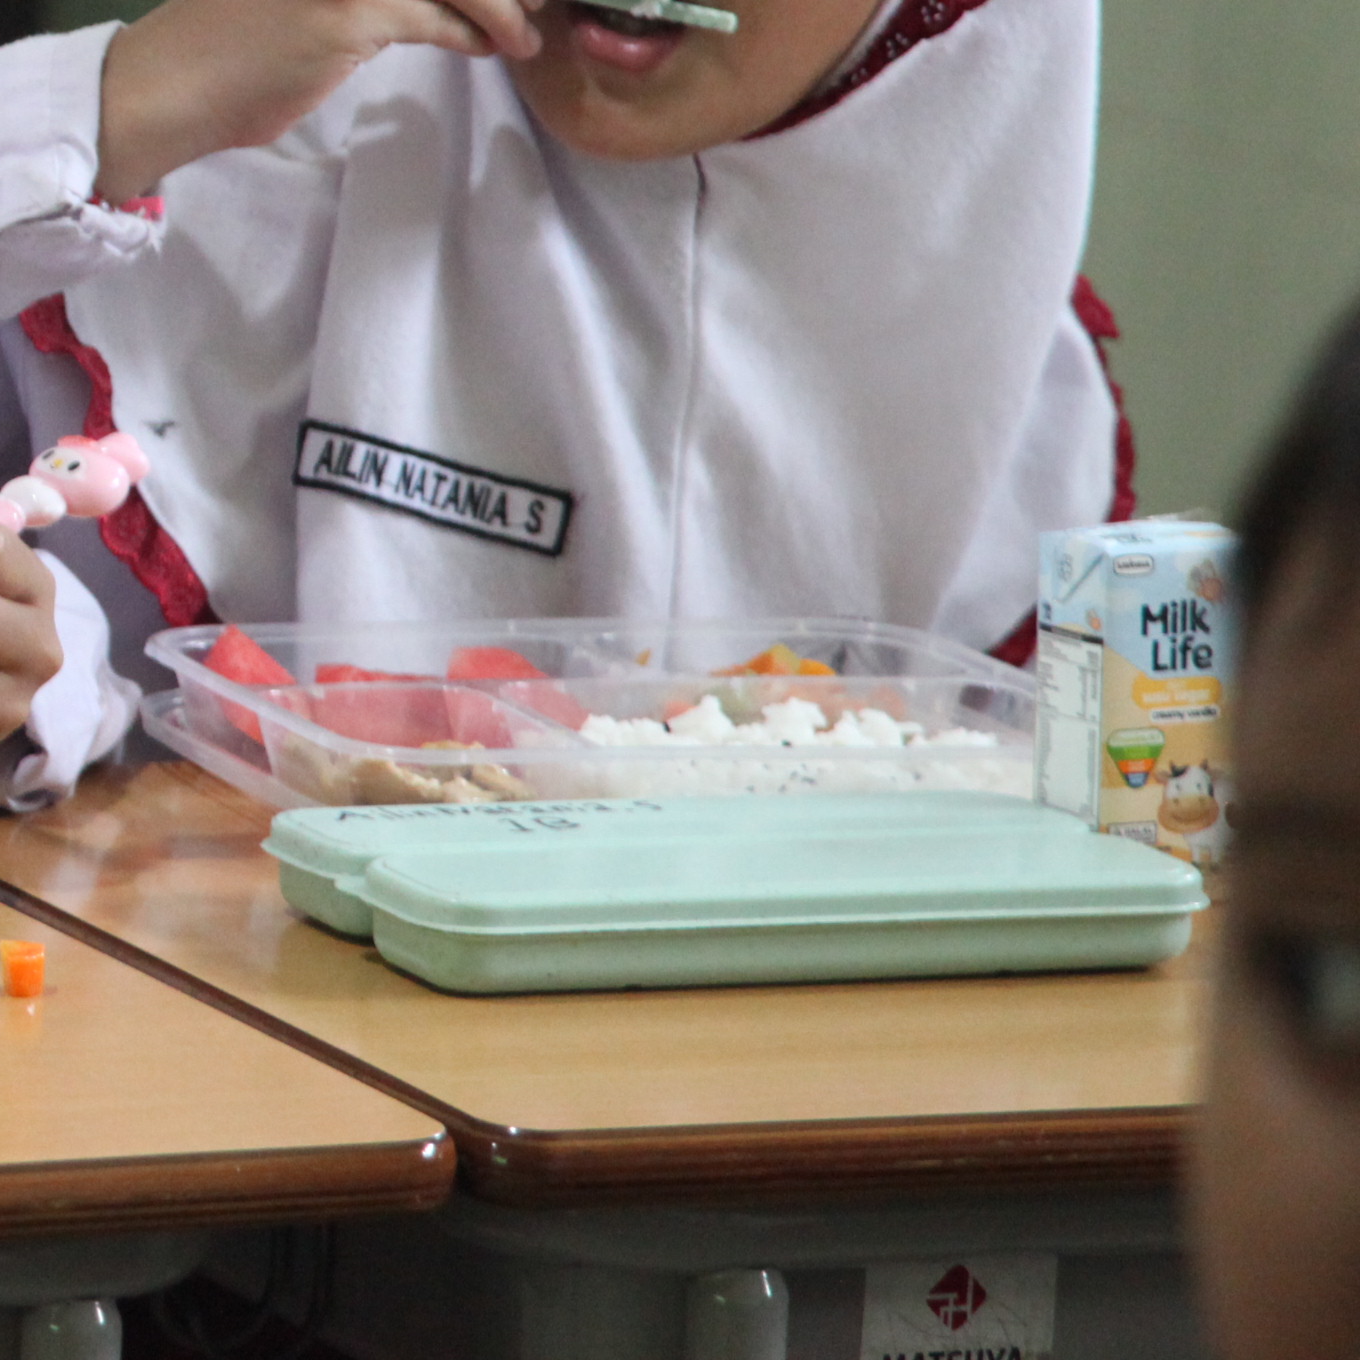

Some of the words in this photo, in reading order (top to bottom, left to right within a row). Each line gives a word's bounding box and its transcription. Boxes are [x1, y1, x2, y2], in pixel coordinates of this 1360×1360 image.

[313, 439, 388, 487] AILIN
[393, 460, 508, 527] NATANIA
[524, 499, 545, 534] S
[1141, 599, 1211, 635] Milk
[1152, 635, 1213, 670] Life
